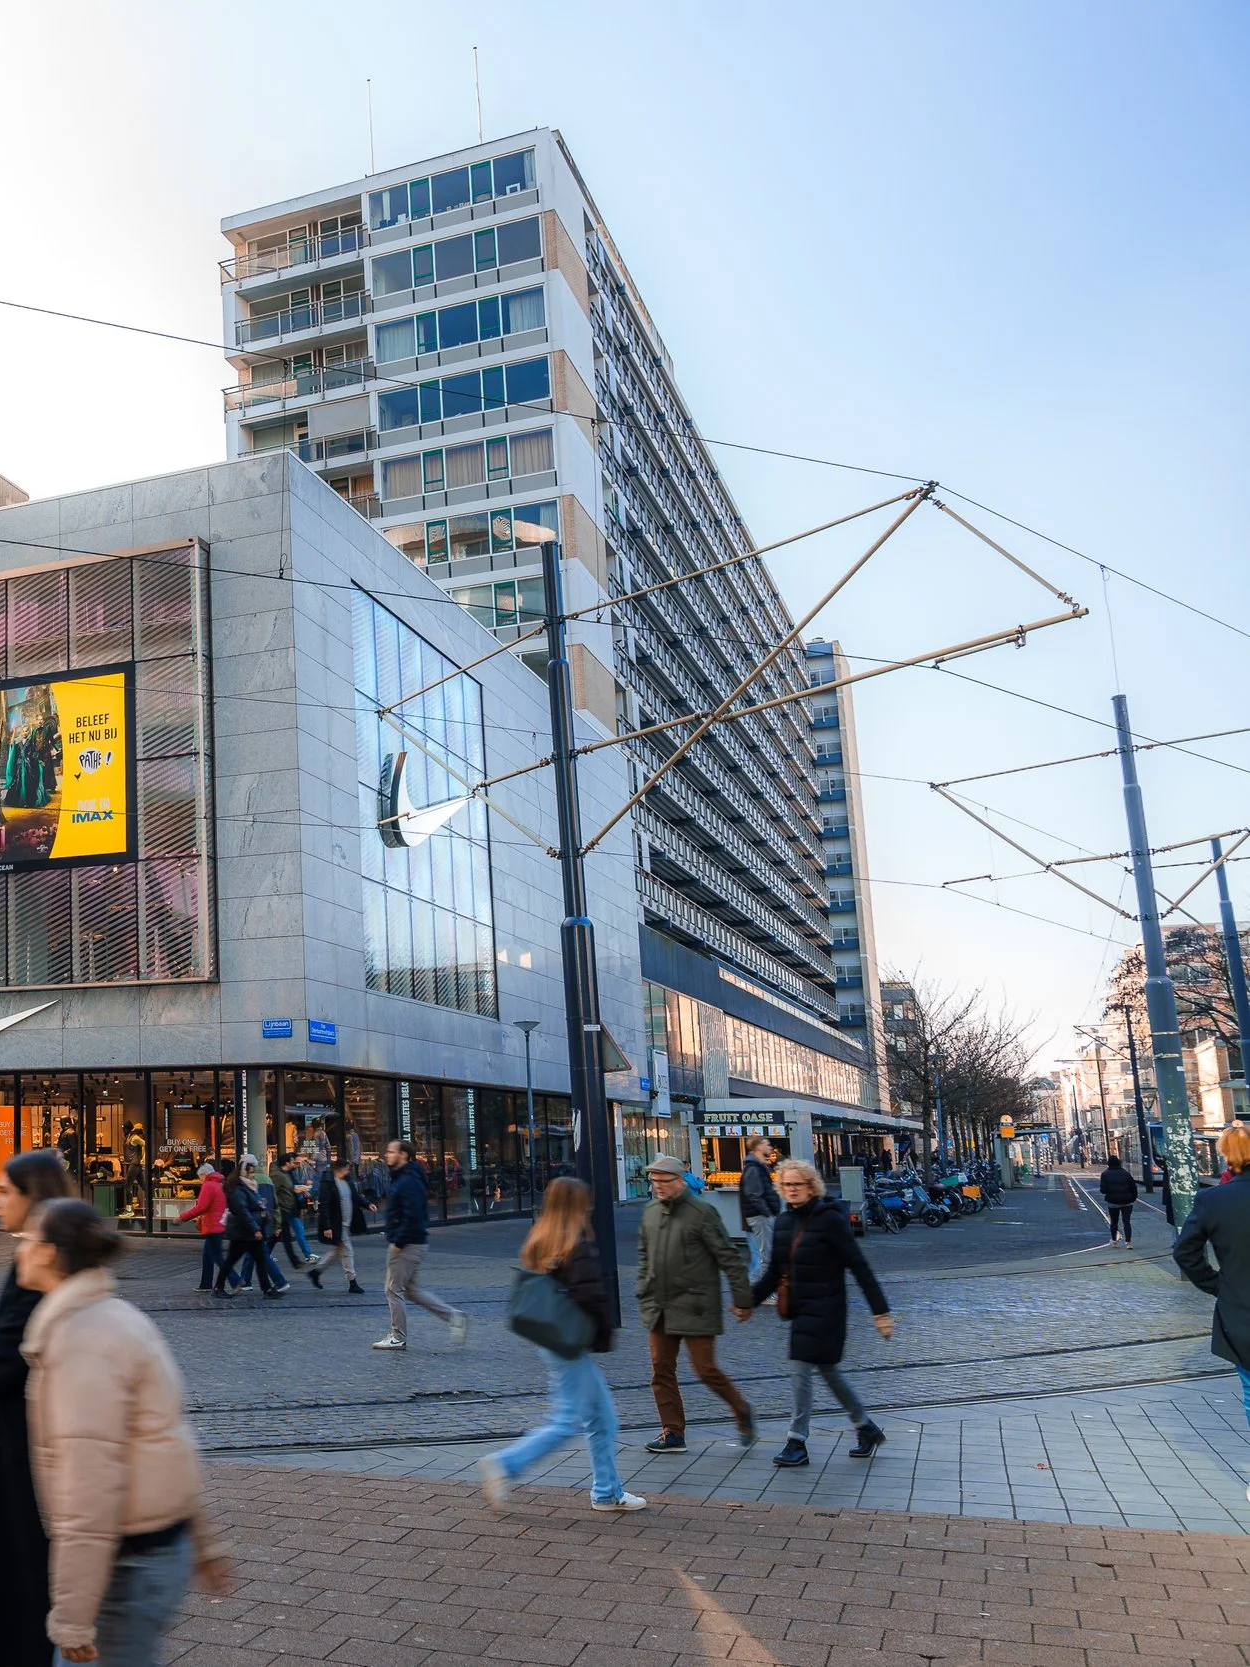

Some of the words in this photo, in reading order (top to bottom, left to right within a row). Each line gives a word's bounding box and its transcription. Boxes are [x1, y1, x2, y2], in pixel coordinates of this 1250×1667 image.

[76, 713, 110, 728] BELEEF
[68, 731, 86, 744] HET
[88, 729, 101, 742] NU
[104, 727, 118, 740] BIJ
[71, 809, 114, 824] IMAX
[264, 1020, 289, 1029] Lijnbaan
[402, 1099, 411, 1132] ATHLETES
[703, 1113, 740, 1123] FRUIT
[741, 1113, 774, 1123] OASE
[166, 1138, 181, 1146] BUY
[159, 1145, 173, 1153] GET
[173, 1145, 188, 1153] ONE
[190, 1145, 207, 1153] FREE
